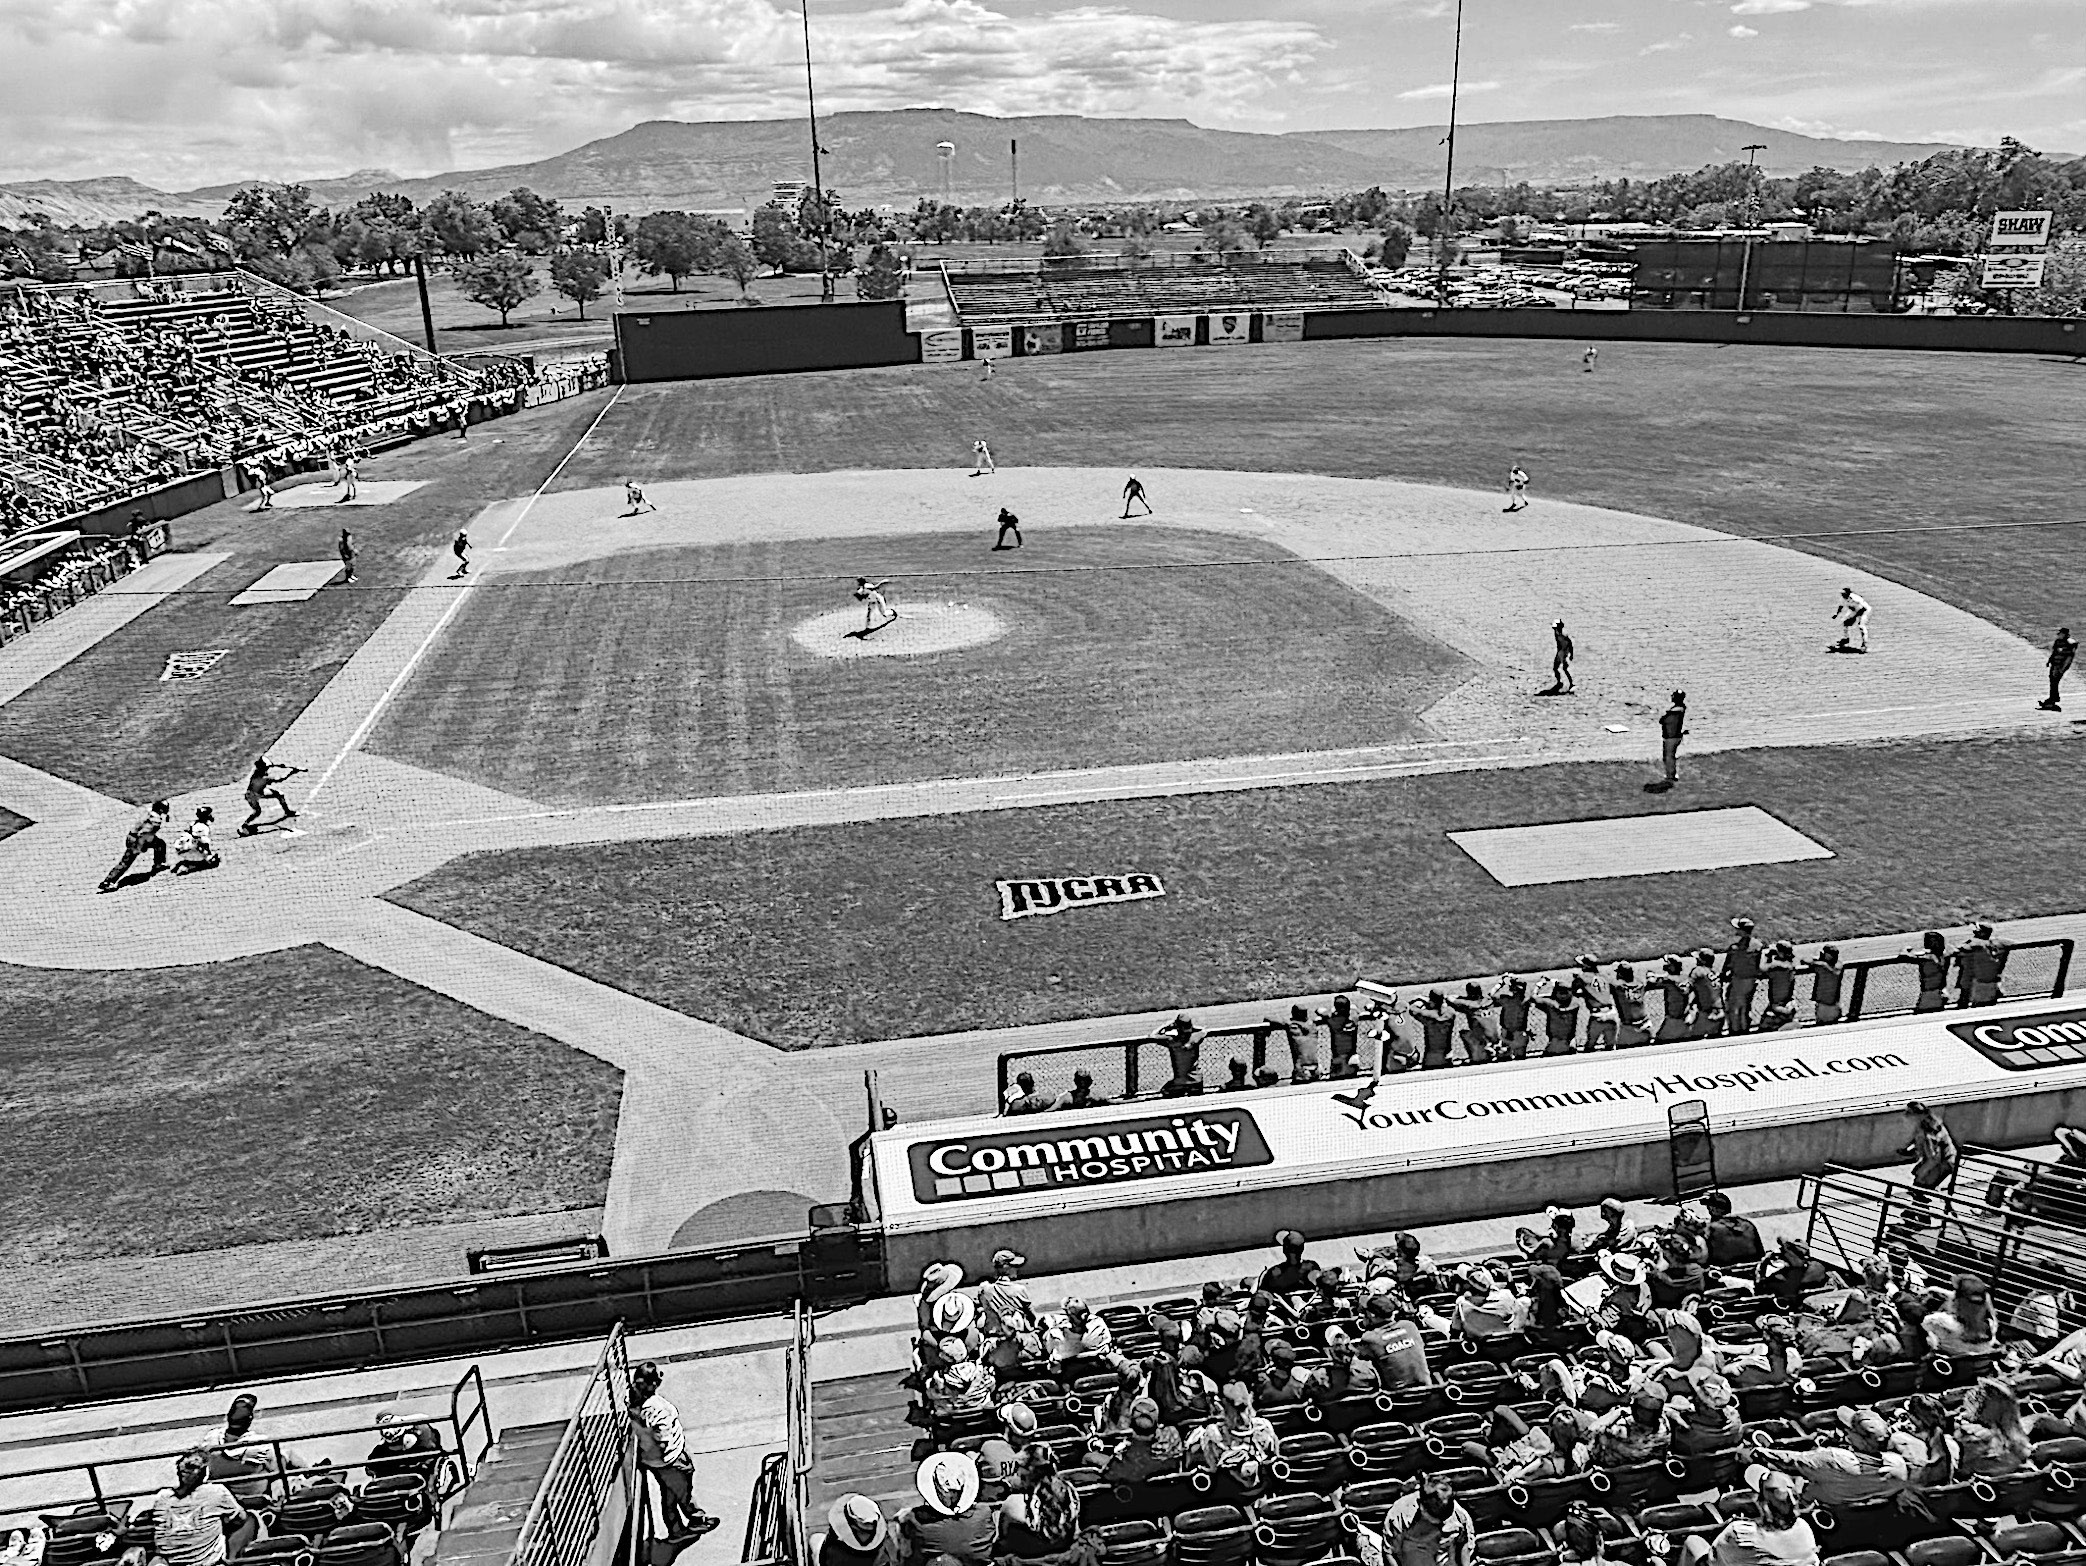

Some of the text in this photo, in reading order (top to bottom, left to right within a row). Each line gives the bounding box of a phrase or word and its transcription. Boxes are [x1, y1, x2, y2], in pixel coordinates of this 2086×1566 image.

[1998, 217, 2046, 231] SHAW
[1974, 1020, 2086, 1049] Com
[1341, 1053, 1909, 1130] YourCommunityHospital.com
[929, 1118, 1240, 1176] Community
[1053, 1148, 1232, 1182] HOSPITAL
